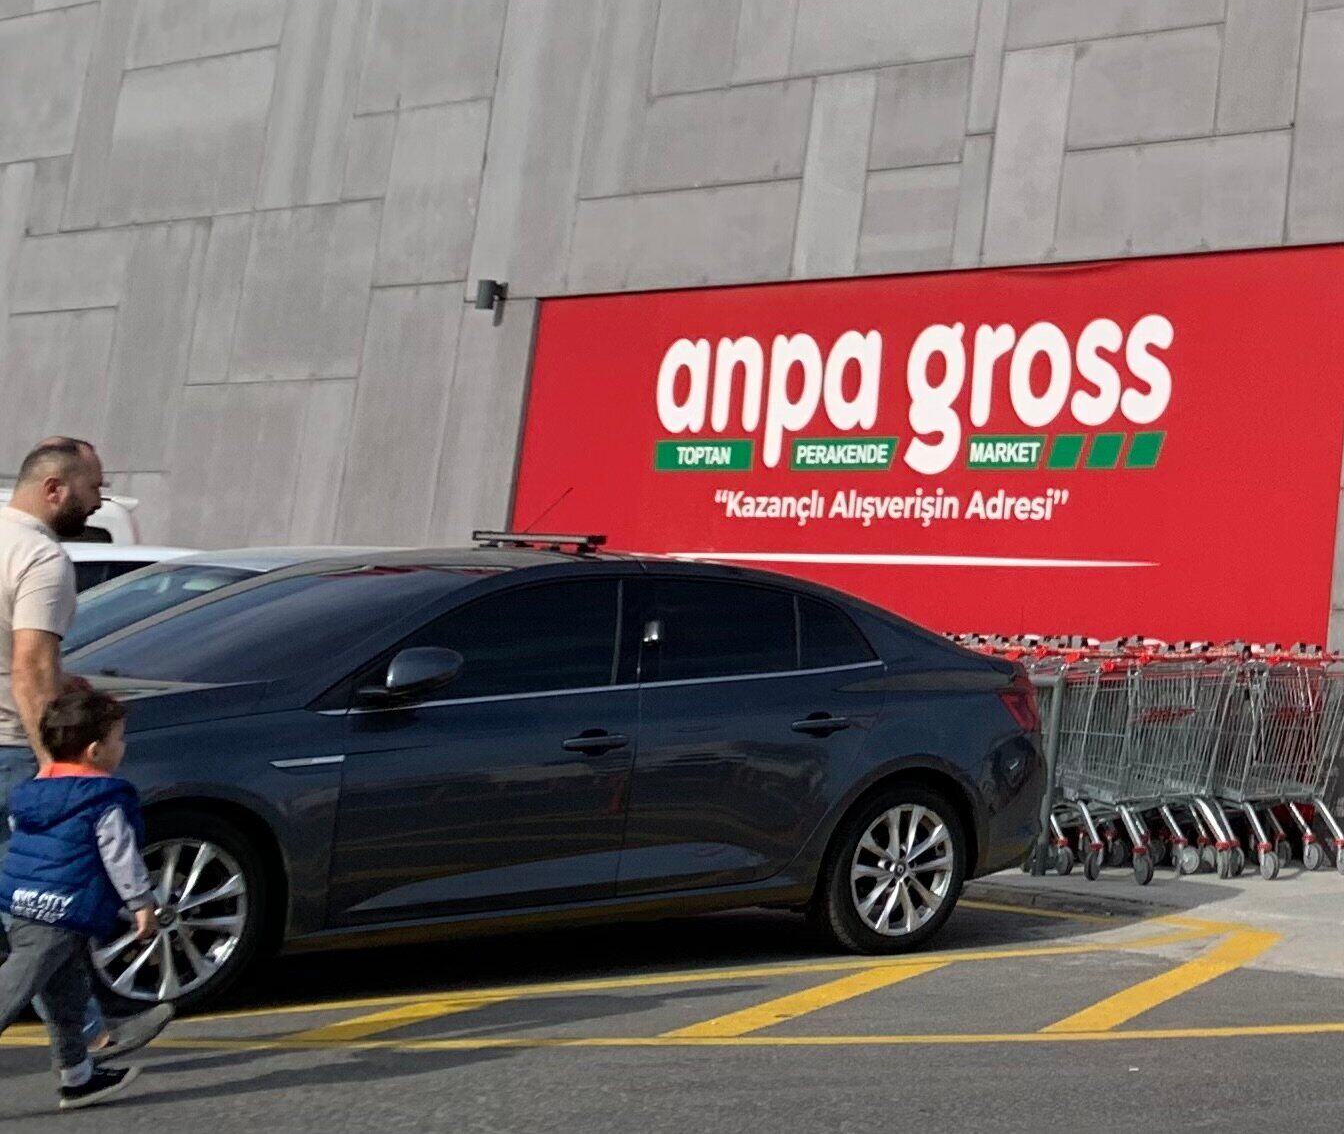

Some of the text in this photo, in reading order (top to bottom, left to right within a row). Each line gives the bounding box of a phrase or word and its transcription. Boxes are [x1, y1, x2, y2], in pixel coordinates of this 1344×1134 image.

[656, 313, 1174, 475] anpa gross
[676, 442, 1041, 465] TOPTAN PERAKENDE MARKET
[714, 488, 1070, 528] “Kazançlı Alışverişin Adresi”
